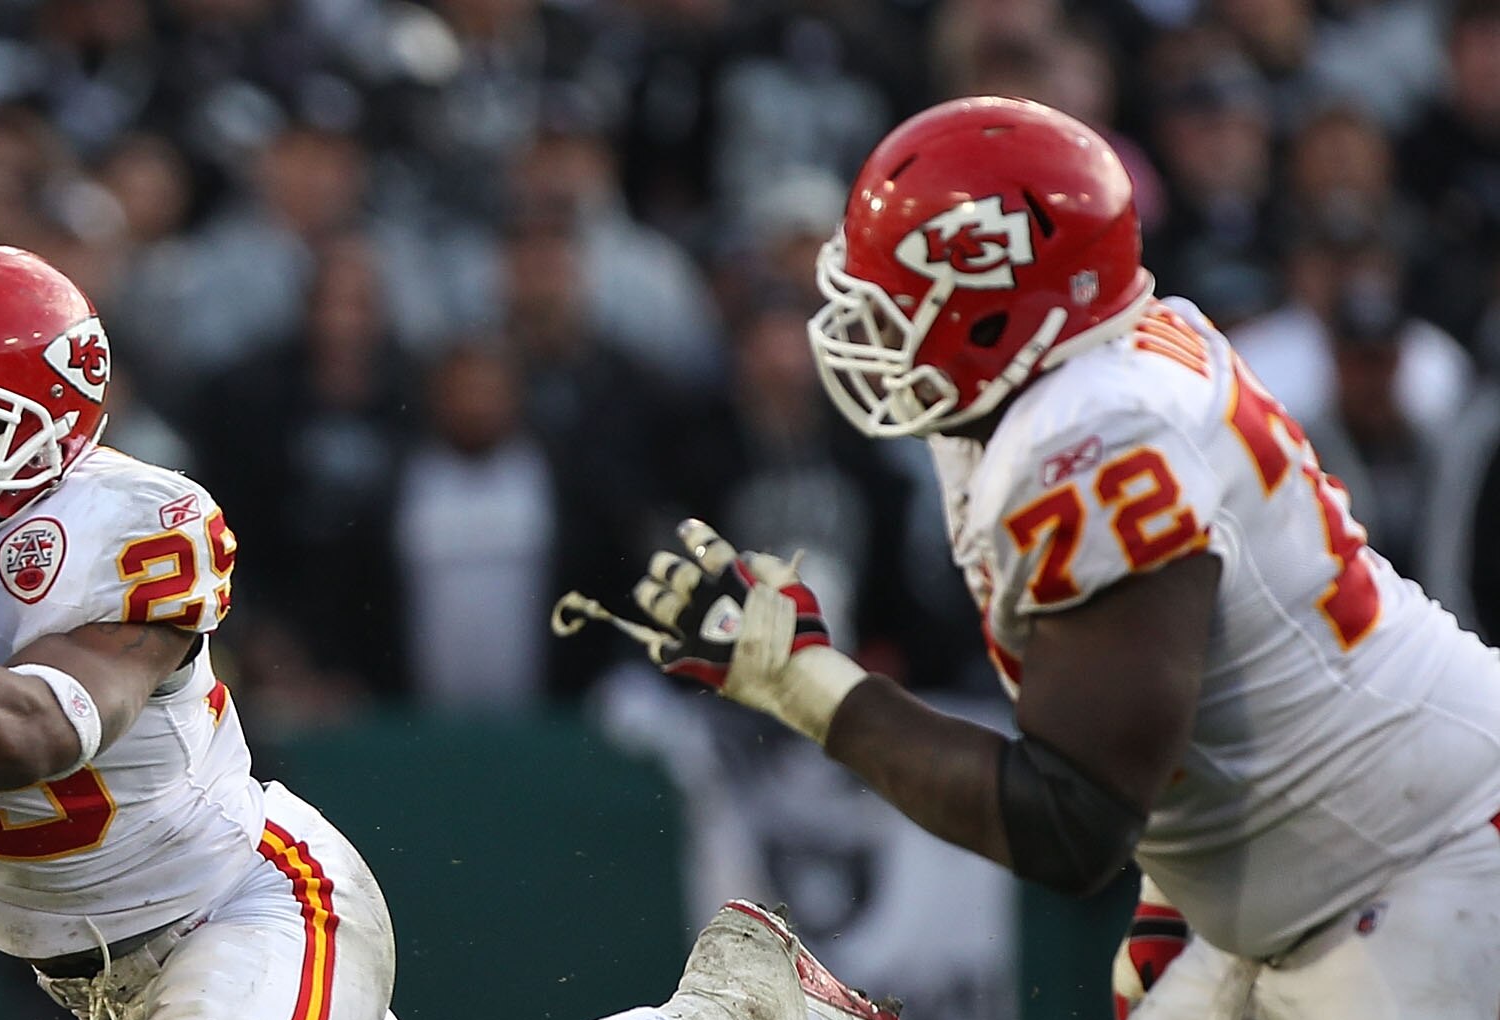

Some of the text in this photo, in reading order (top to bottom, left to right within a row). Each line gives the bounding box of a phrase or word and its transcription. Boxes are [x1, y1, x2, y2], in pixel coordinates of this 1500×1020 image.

[923, 222, 1009, 274] KC
[66, 334, 108, 386] KC
[1002, 445, 1204, 606] 72
